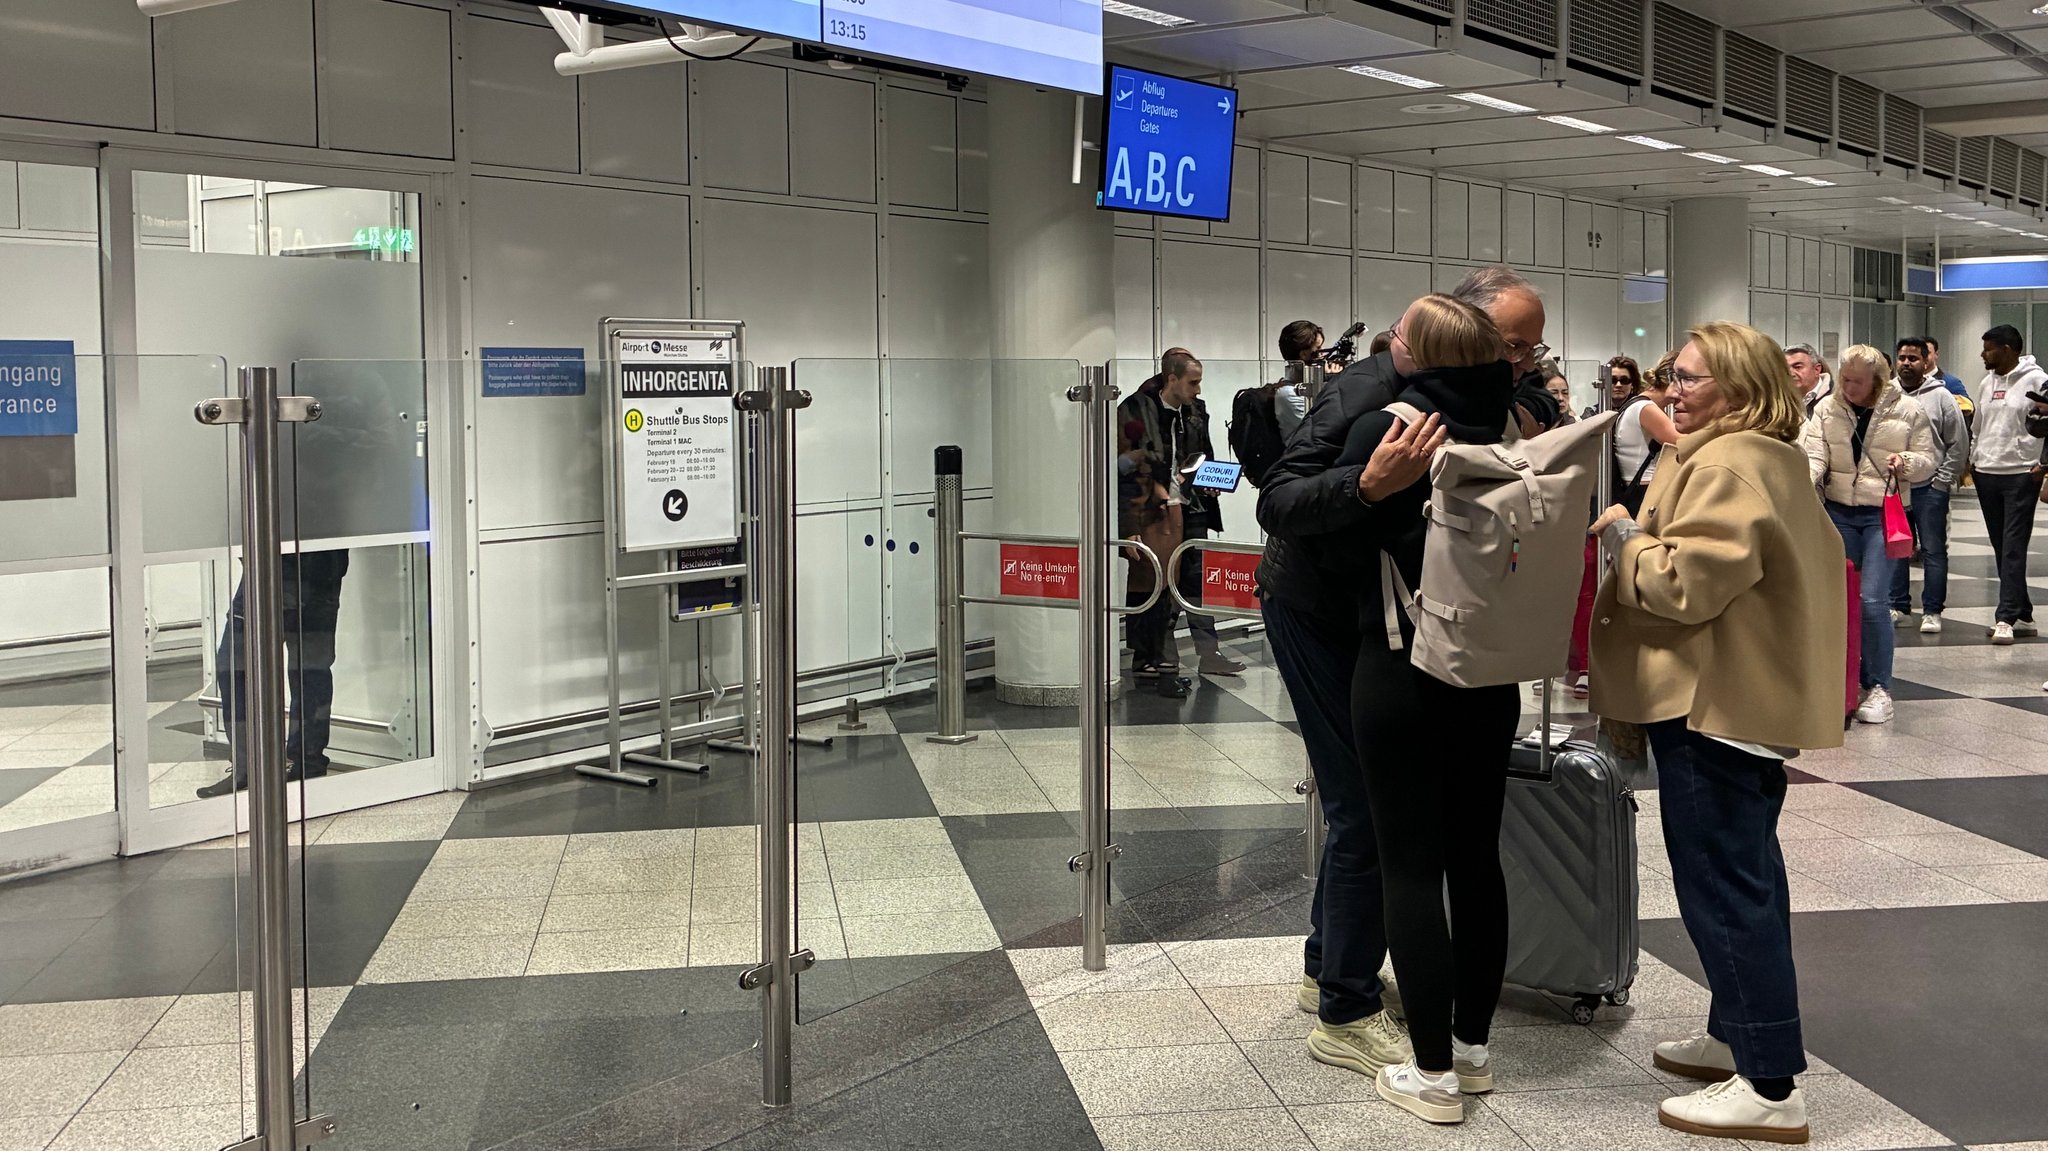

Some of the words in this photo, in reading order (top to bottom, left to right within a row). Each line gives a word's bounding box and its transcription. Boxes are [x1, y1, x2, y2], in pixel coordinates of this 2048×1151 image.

[830, 19, 866, 41] 13:15
[1142, 80, 1166, 100] Abflug
[1141, 99, 1179, 119] Departures
[1140, 118, 1160, 135] Gates
[622, 342, 649, 353] Airport
[663, 342, 688, 352] Messe
[0, 366, 62, 387] ngang
[623, 370, 729, 392] INHORGENTA
[629, 414, 638, 427] H
[646, 416, 680, 426] Shuttle
[682, 415, 701, 425] Bus
[702, 414, 729, 426] Stops
[647, 429, 672, 437] Terminal
[647, 449, 675, 458] Departure
[676, 449, 693, 457] every
[1204, 466, 1234, 476] CODURI
[1196, 474, 1235, 485] VERONICA
[1020, 560, 1043, 572] Keine
[1045, 562, 1077, 574] Umkehr
[1020, 570, 1032, 581] No
[1033, 573, 1067, 586] re-entry
[1225, 568, 1250, 581] Keine
[1225, 580, 1238, 591] No
